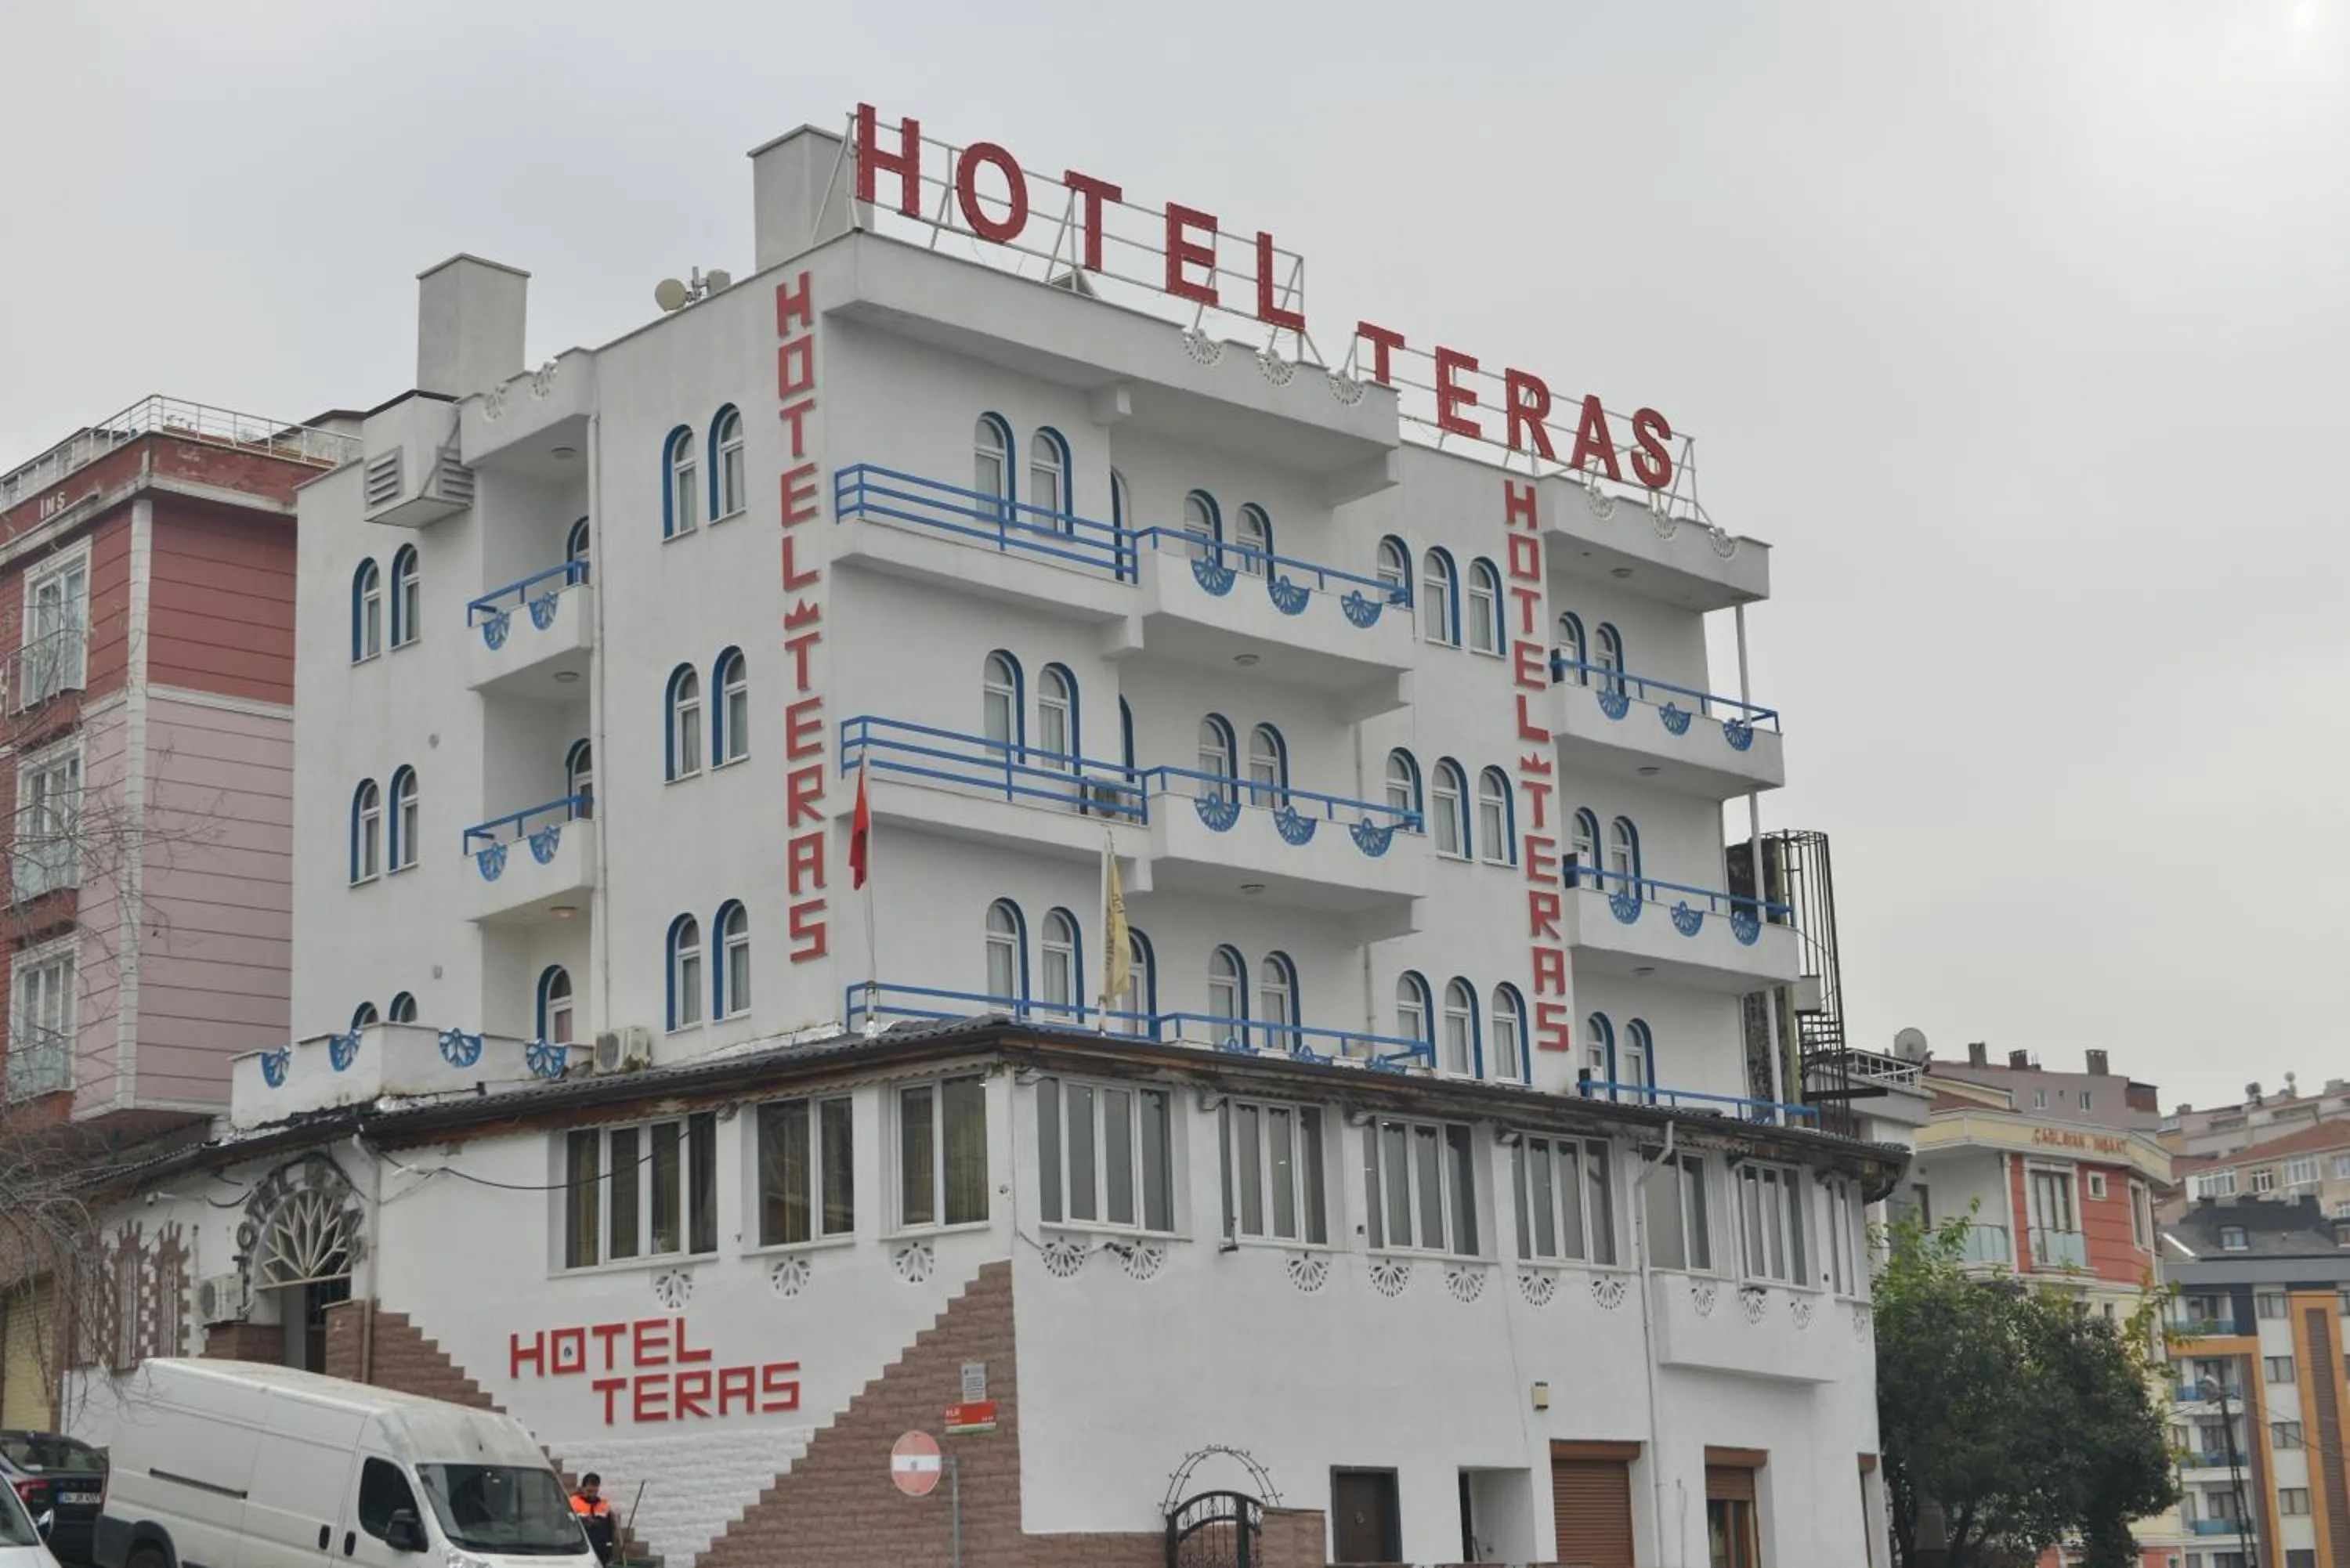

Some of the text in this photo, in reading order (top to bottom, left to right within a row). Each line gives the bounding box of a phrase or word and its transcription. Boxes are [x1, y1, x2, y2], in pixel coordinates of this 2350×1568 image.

[856, 103, 1672, 488] HOTEL TERAS
[776, 271, 828, 963] HOTEL TERAS
[1504, 479, 1569, 1052] HOTEL TERAS
[510, 1317, 711, 1378] HOTEL
[592, 1361, 800, 1425] TERAS
